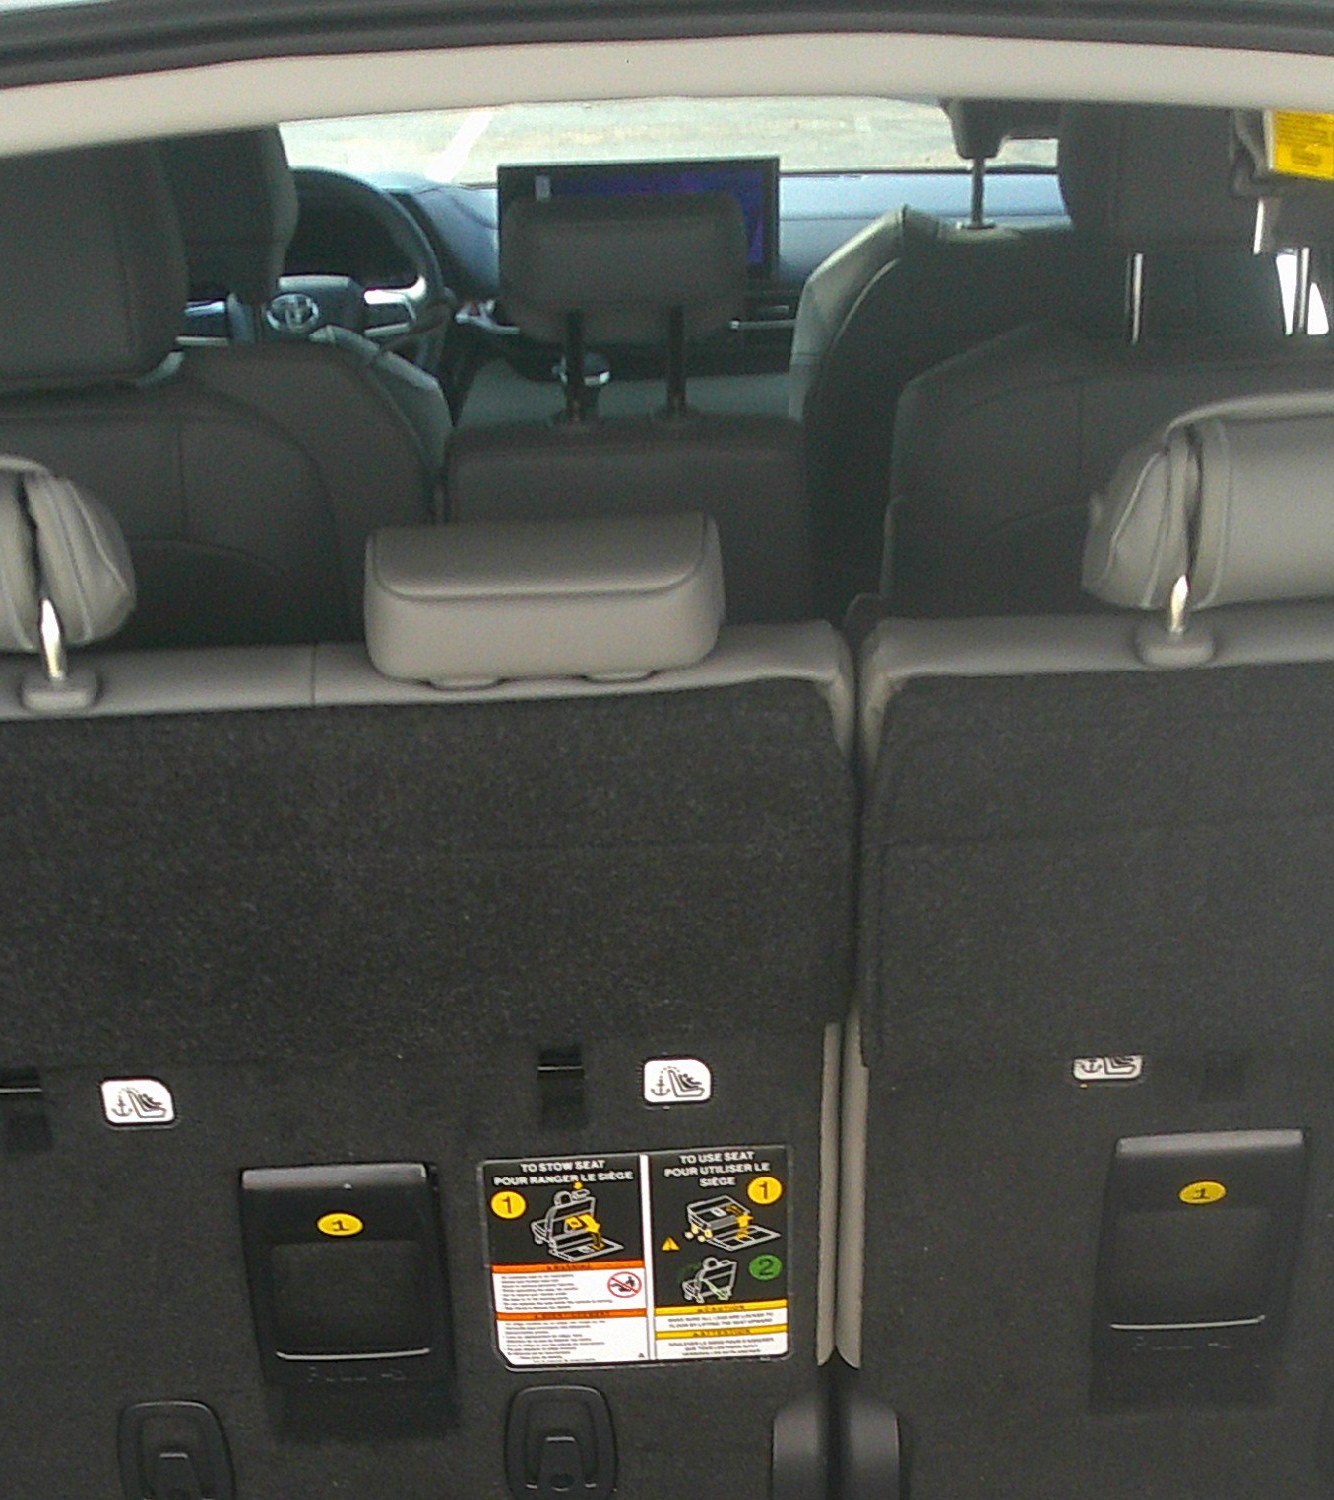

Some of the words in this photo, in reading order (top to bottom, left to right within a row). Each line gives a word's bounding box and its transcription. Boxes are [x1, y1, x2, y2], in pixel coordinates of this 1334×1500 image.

[679, 1155, 697, 1165] TO
[698, 1153, 723, 1163] USE
[724, 1151, 755, 1161] SEAT
[520, 1163, 538, 1173] TO
[539, 1162, 573, 1173] STOW
[575, 1160, 605, 1170] SEAT
[663, 1167, 698, 1177] POUR
[699, 1164, 753, 1175] UTILISER
[754, 1162, 771, 1172] LE
[493, 1176, 528, 1186] POUR
[529, 1174, 579, 1184] RANGER
[581, 1173, 596, 1182] LE
[758, 1258, 774, 1276] 2
